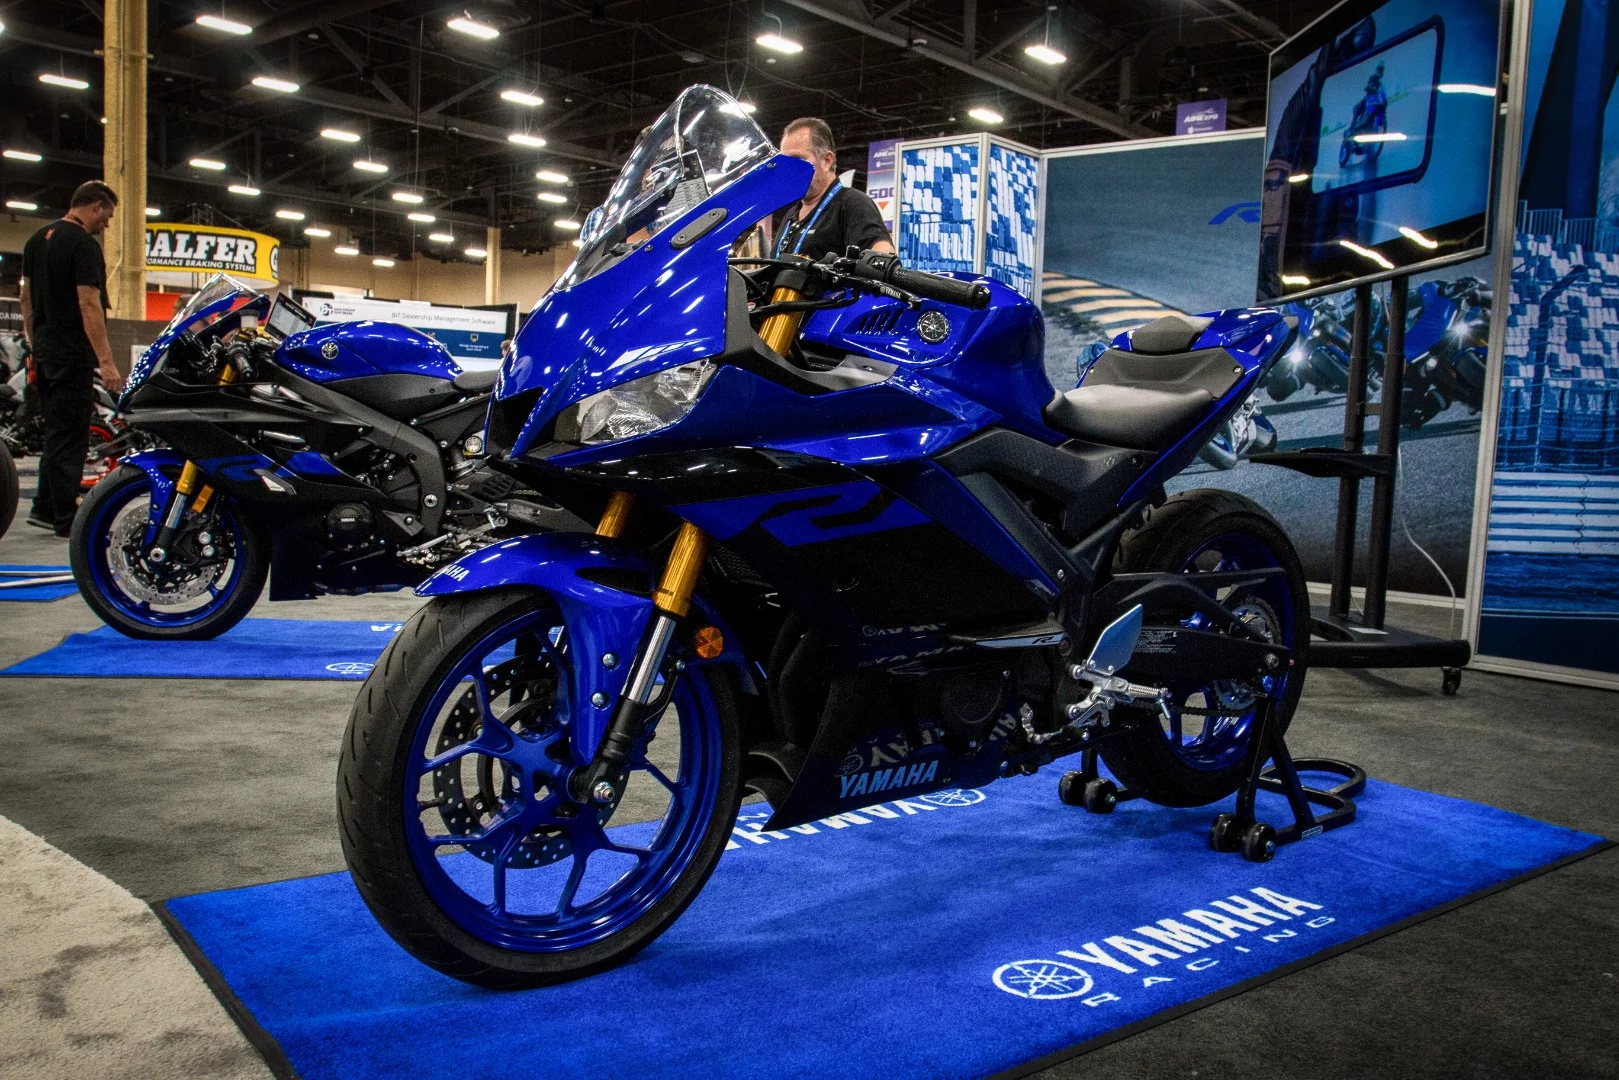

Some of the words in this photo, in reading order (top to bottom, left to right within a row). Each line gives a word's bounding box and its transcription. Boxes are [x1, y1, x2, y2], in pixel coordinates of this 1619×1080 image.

[147, 257, 183, 266] ORMANCE
[185, 259, 223, 269] BRAKING
[225, 262, 256, 273] SYSTEMS
[402, 312, 432, 322] Dealership
[433, 315, 470, 325] Management
[471, 318, 496, 326] Software
[840, 760, 939, 799] YAMAHA
[1056, 886, 1324, 975] YAMAHA
[1080, 915, 1337, 1008] RACING
